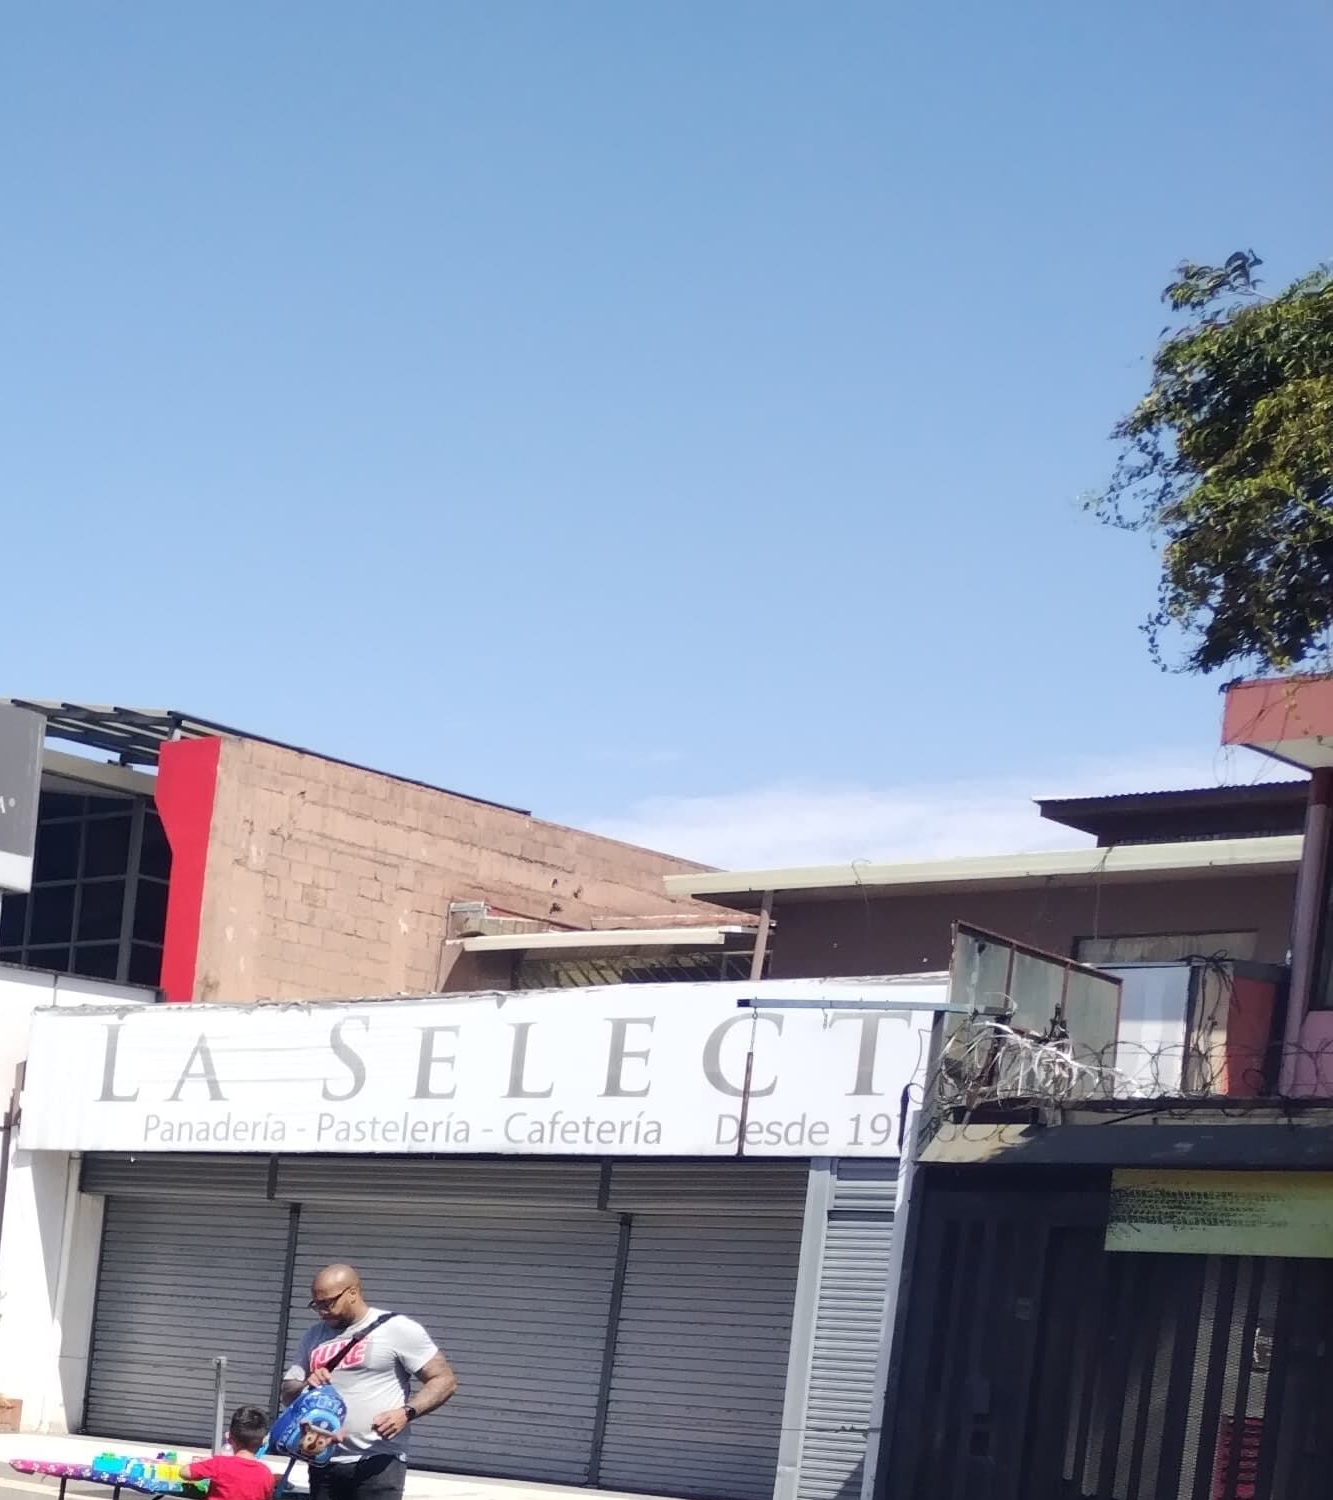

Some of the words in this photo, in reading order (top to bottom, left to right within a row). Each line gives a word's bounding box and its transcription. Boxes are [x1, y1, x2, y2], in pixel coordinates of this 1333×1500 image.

[95, 1022, 229, 1102] LA
[321, 1011, 912, 1102] SELECT
[143, 1112, 286, 1143] Panadería
[317, 1111, 470, 1144] Pastelería
[504, 1110, 662, 1145] Cafetería
[715, 1113, 829, 1146] Desde
